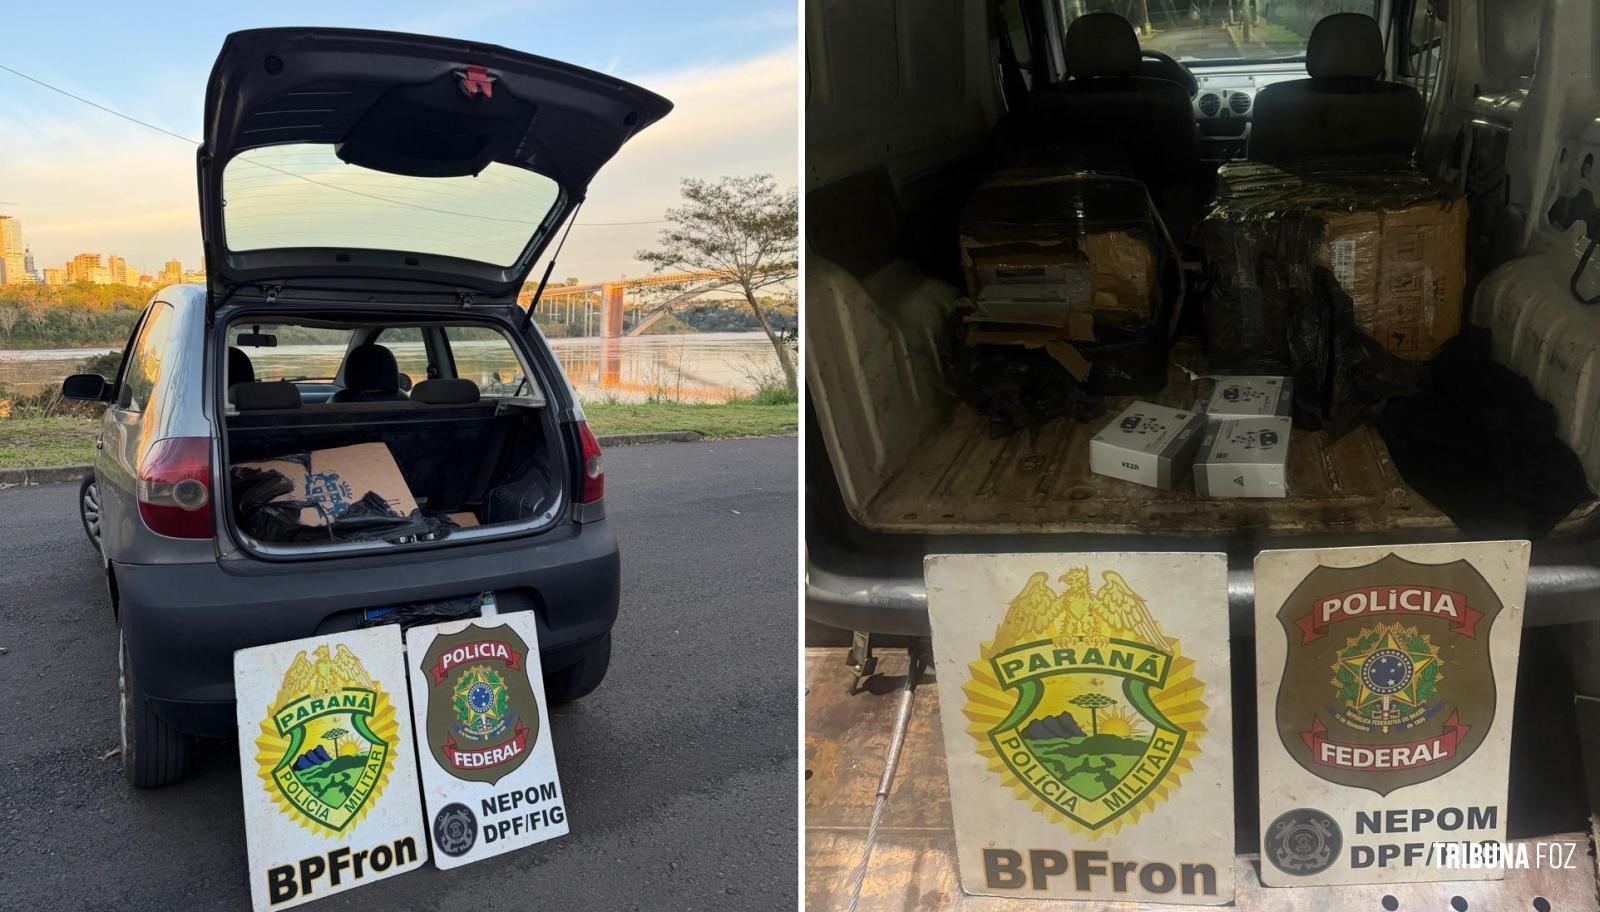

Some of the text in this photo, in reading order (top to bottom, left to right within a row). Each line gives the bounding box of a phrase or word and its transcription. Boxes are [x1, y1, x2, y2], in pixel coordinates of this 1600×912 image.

[1001, 647, 1159, 680] PARANÁ
[280, 693, 372, 730] PARANÁ
[453, 740, 522, 768] FEDERAL
[1320, 739, 1448, 769] FEDERAL
[344, 750, 384, 813] MILITAR
[1000, 736, 1174, 813] POLÍCIA MILITAR
[480, 781, 558, 817] NEPOM
[482, 805, 565, 845] DPF/FIG
[1354, 805, 1498, 835] NEPOM
[266, 835, 418, 906] BPFron
[981, 847, 1218, 896] BPFron
